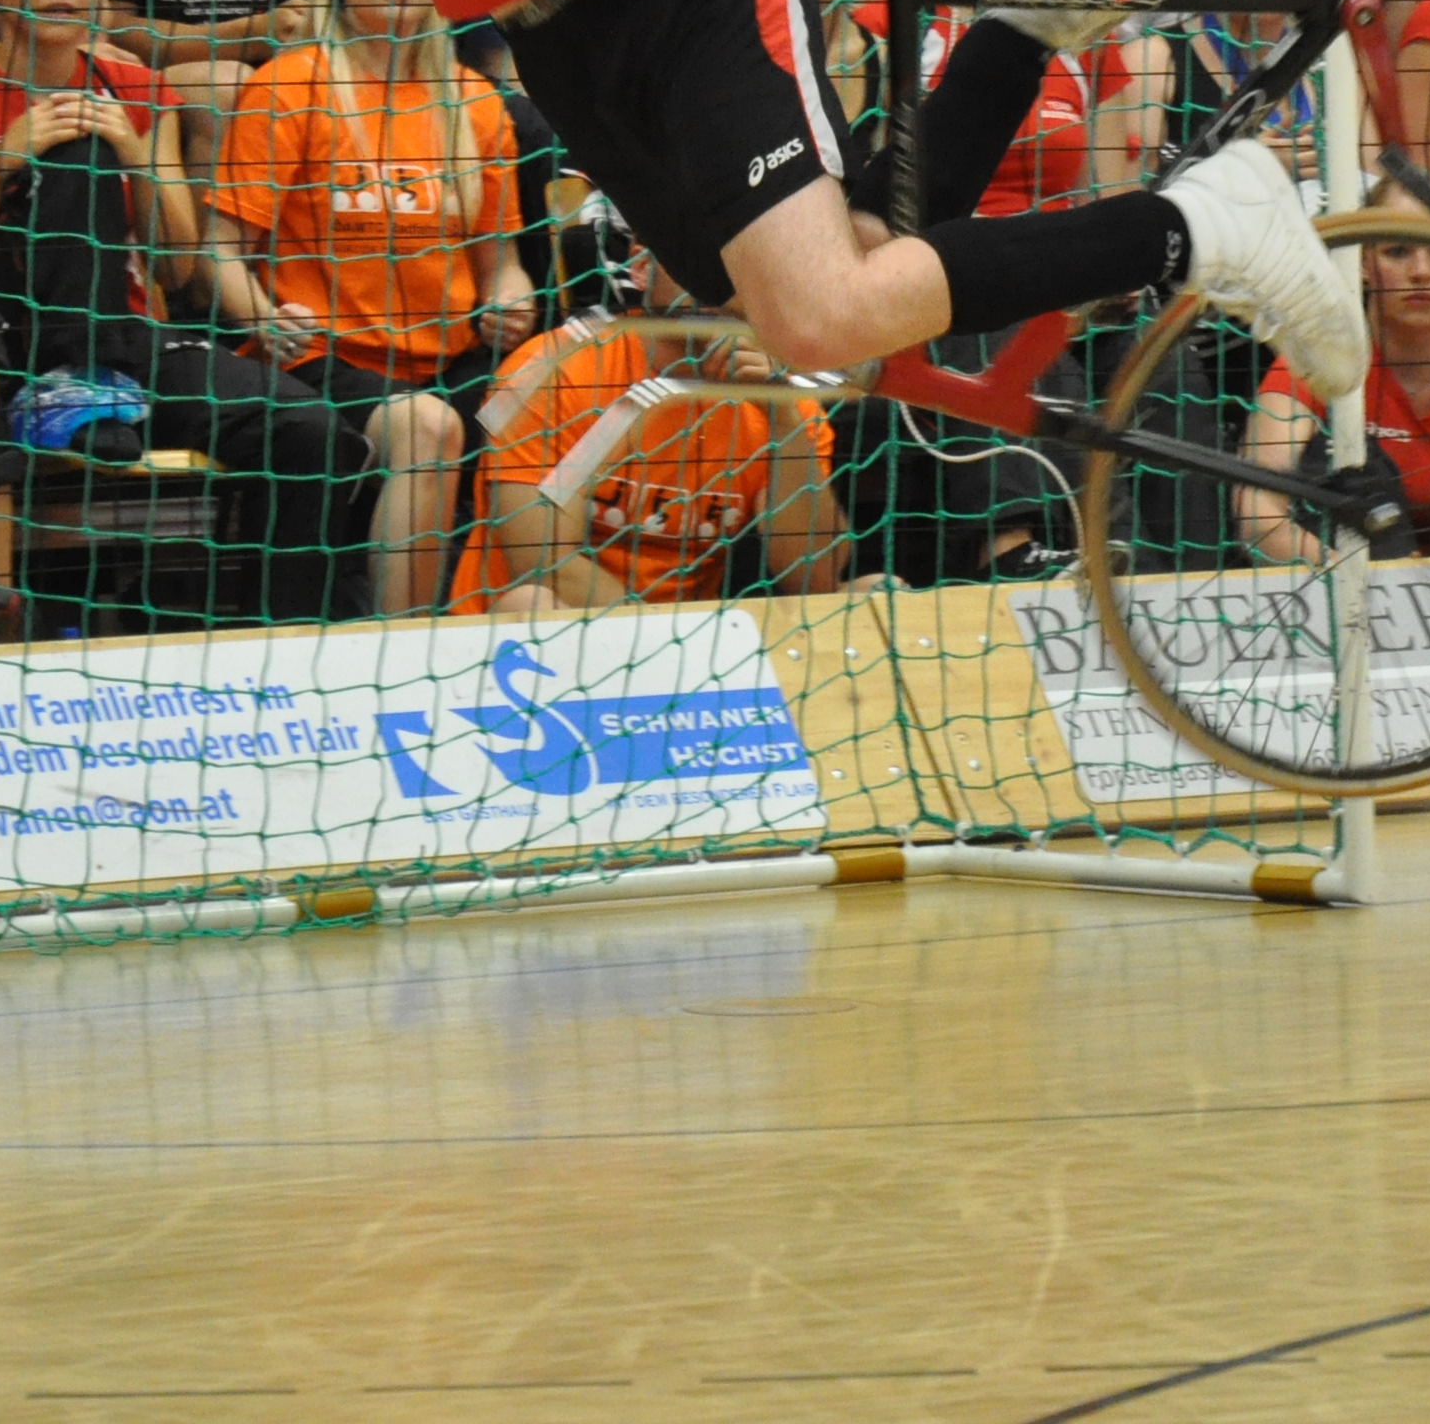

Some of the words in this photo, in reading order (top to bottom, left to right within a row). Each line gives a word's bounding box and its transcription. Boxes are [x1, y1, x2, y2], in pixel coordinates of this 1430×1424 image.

[765, 137, 805, 170] asics
[26, 680, 242, 727] Familienfest
[249, 677, 296, 713] im
[599, 705, 790, 737] SCHWANEN
[1063, 699, 1273, 742] STEINETZ
[70, 725, 275, 771] besonderen
[285, 716, 361, 758] Flair
[668, 740, 801, 770] HÖCHST
